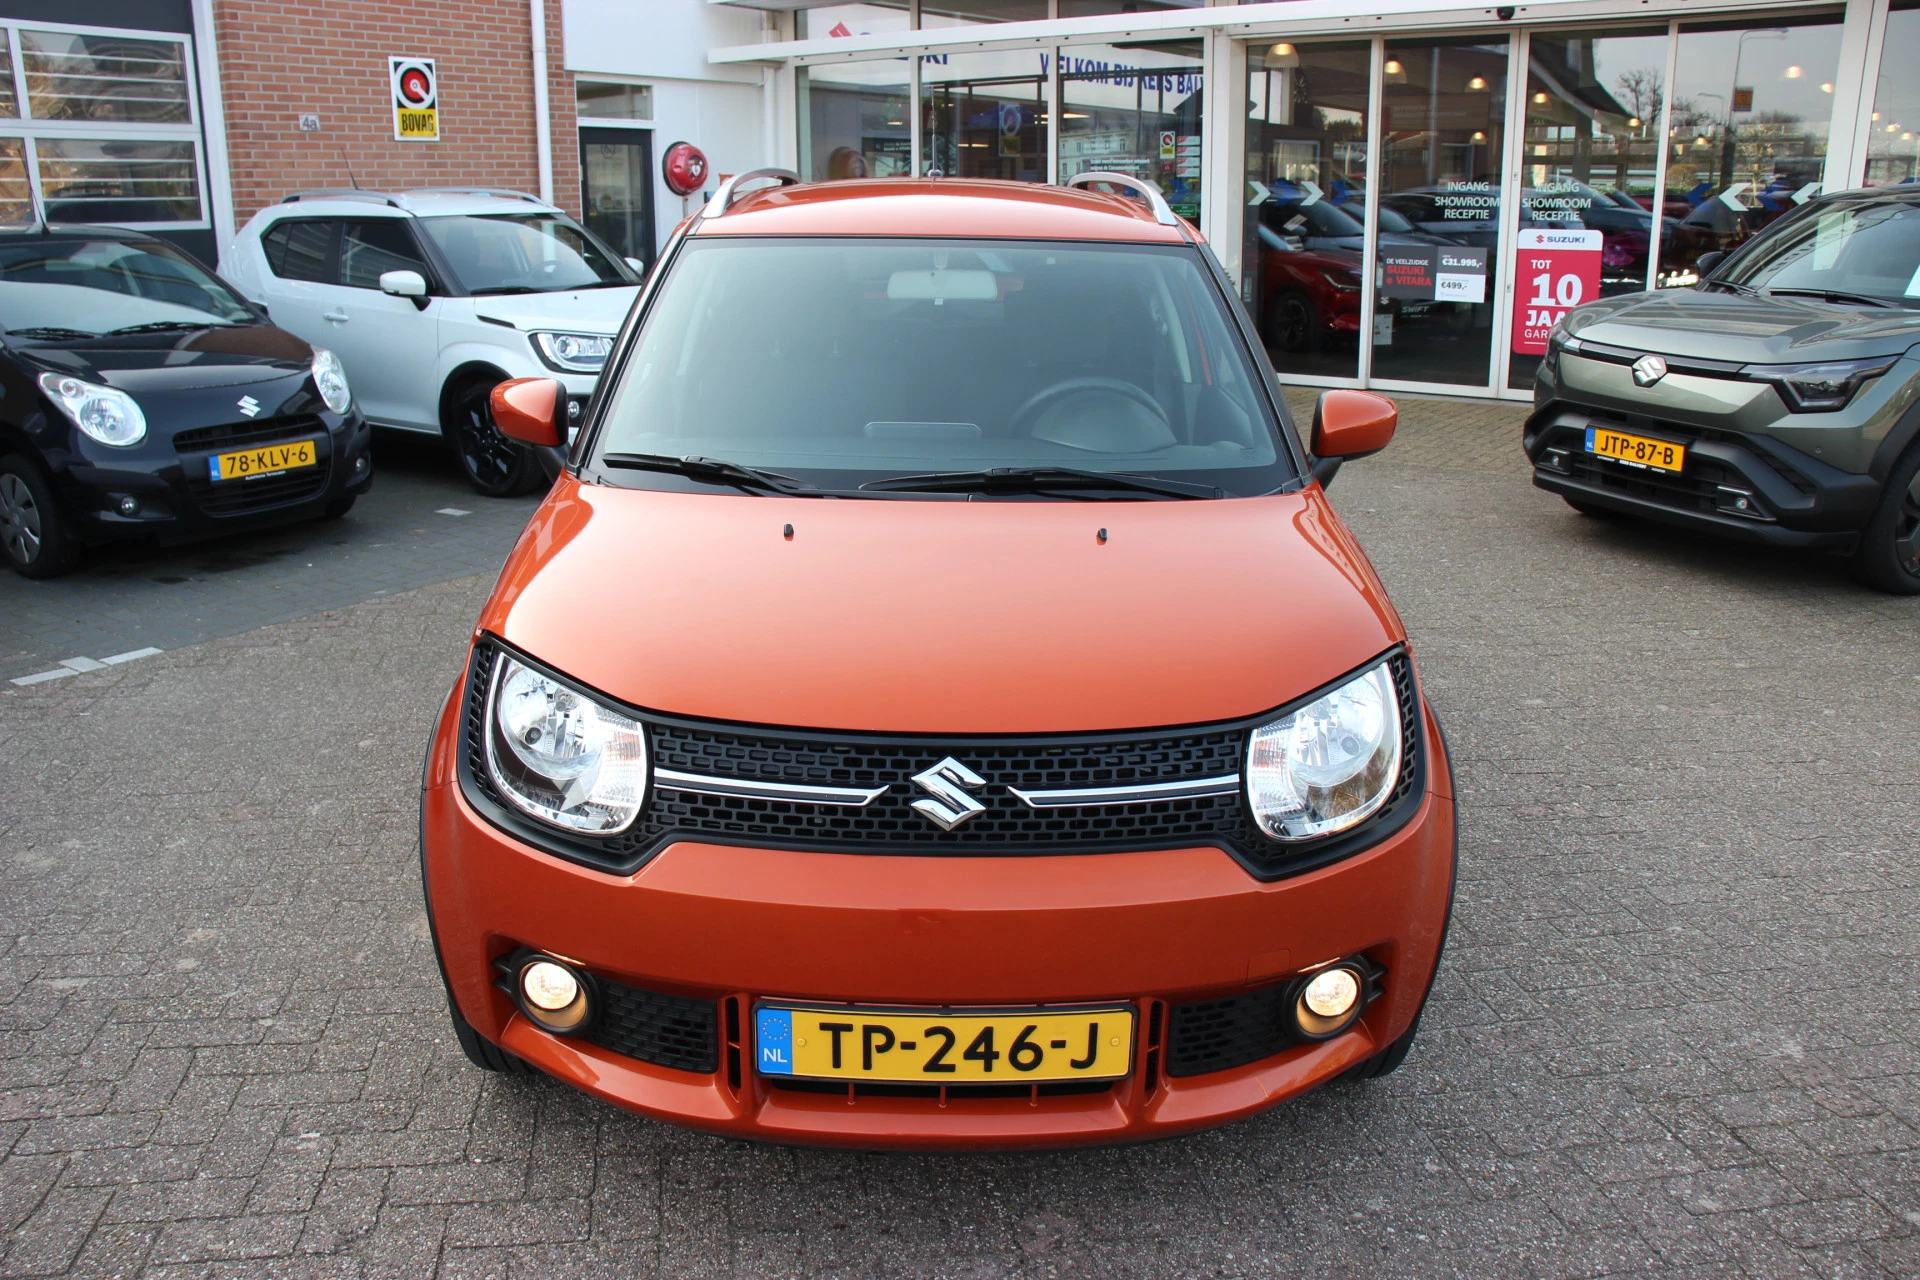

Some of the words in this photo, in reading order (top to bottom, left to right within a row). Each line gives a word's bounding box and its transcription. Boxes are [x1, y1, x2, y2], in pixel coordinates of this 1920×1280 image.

[302, 117, 318, 129] 4a
[401, 114, 434, 132] BOVAG
[1447, 181, 1489, 192] INGANG
[1536, 182, 1580, 193] INGANG
[1435, 196, 1500, 207] SHOWROOM
[1522, 198, 1592, 209] SHOWROOM
[1444, 208, 1490, 220] RECEPTIE
[1532, 210, 1580, 221] RECEPTIE
[1547, 236, 1586, 244] SUZUKI
[1531, 259, 1552, 269] TOT
[1387, 265, 1425, 275] SUZUKI
[1396, 276, 1432, 286] VITARA
[1441, 281, 1468, 290] €499,-
[1531, 273, 1583, 307] 10
[1525, 309, 1567, 327] JAA
[1524, 329, 1549, 339] GAR
[1600, 435, 1674, 465] JTP-87-B
[226, 445, 308, 474] 78-KLV-6
[763, 1048, 788, 1064] NL
[818, 1022, 1099, 1073] TP-246-J
